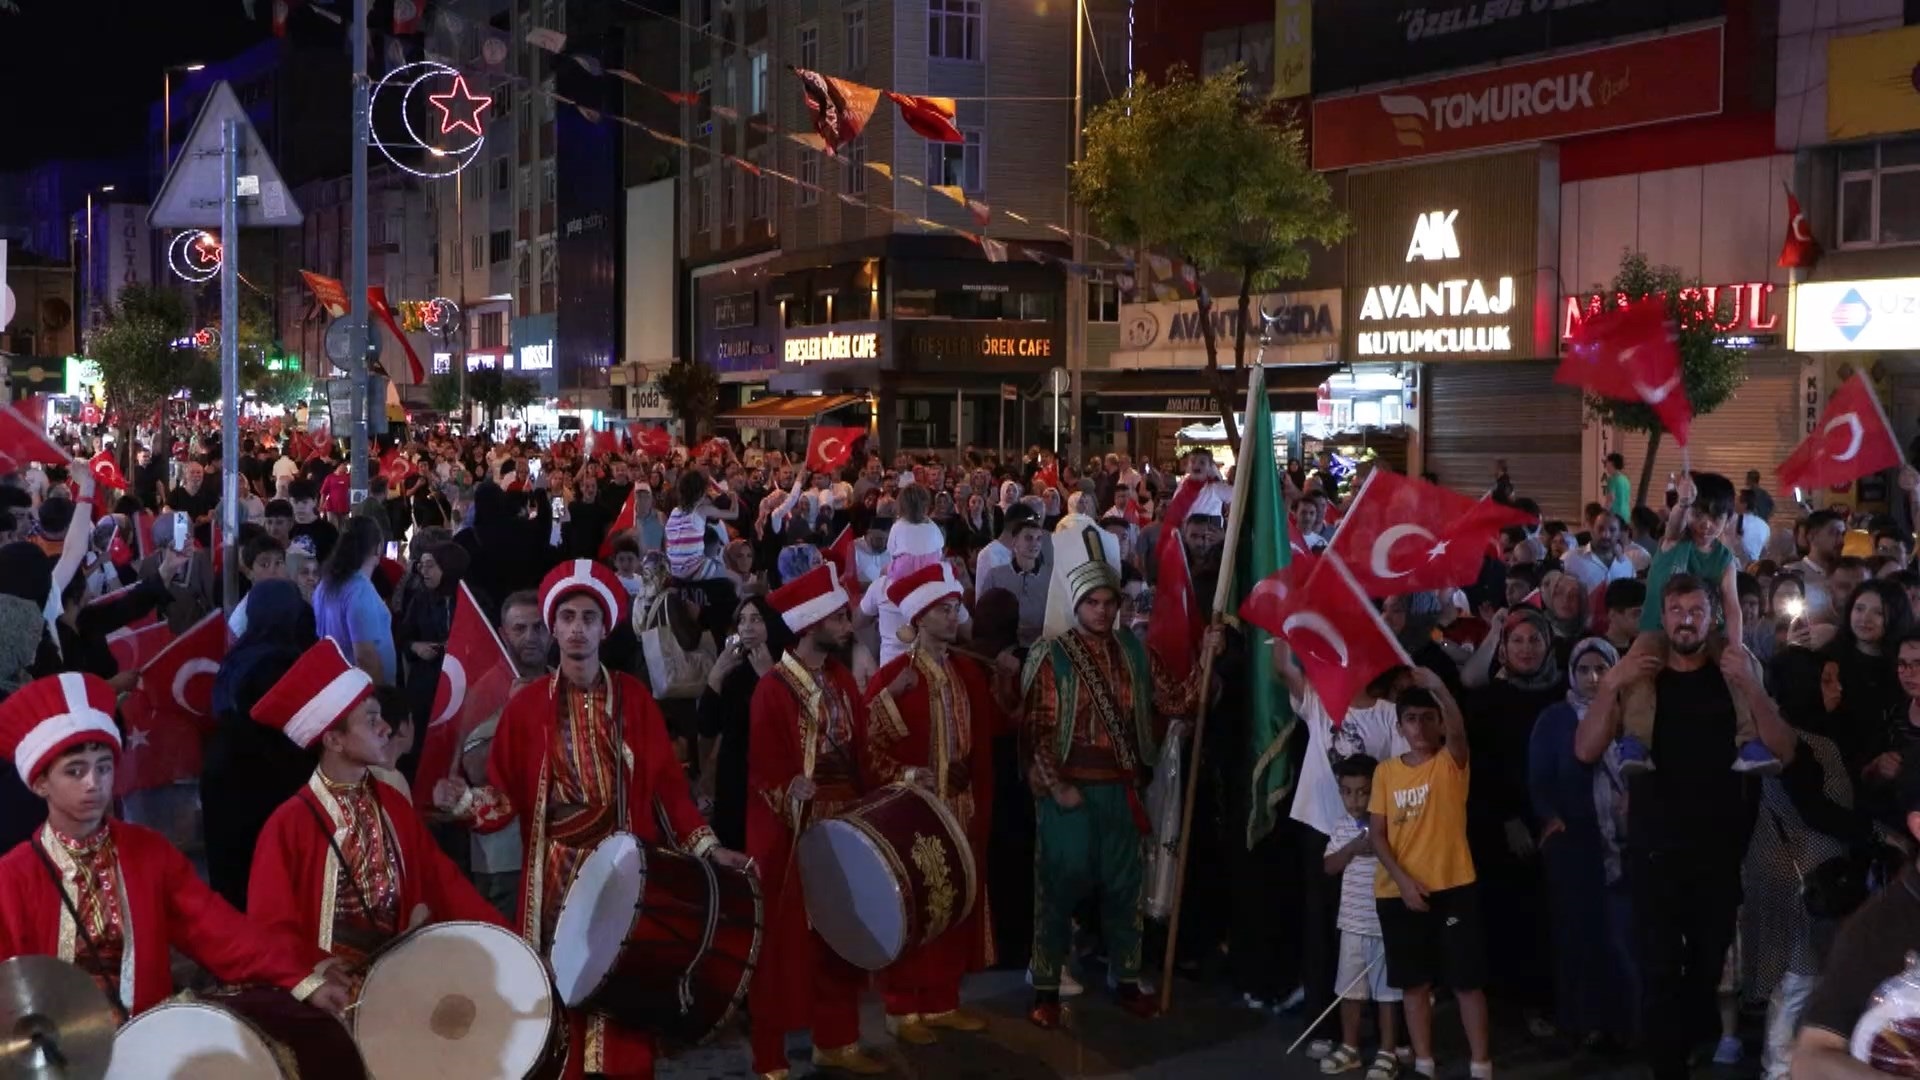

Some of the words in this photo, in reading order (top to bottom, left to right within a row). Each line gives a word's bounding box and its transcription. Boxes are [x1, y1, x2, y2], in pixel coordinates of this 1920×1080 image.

[1431, 71, 1595, 132] TOMURCUK
[1405, 209, 1461, 263] AK
[1359, 276, 1515, 321] AVANTAJ
[852, 333, 876, 359] CAFE
[1018, 338, 1051, 357] CAFE
[1358, 325, 1511, 355] KUYUMCULUK
